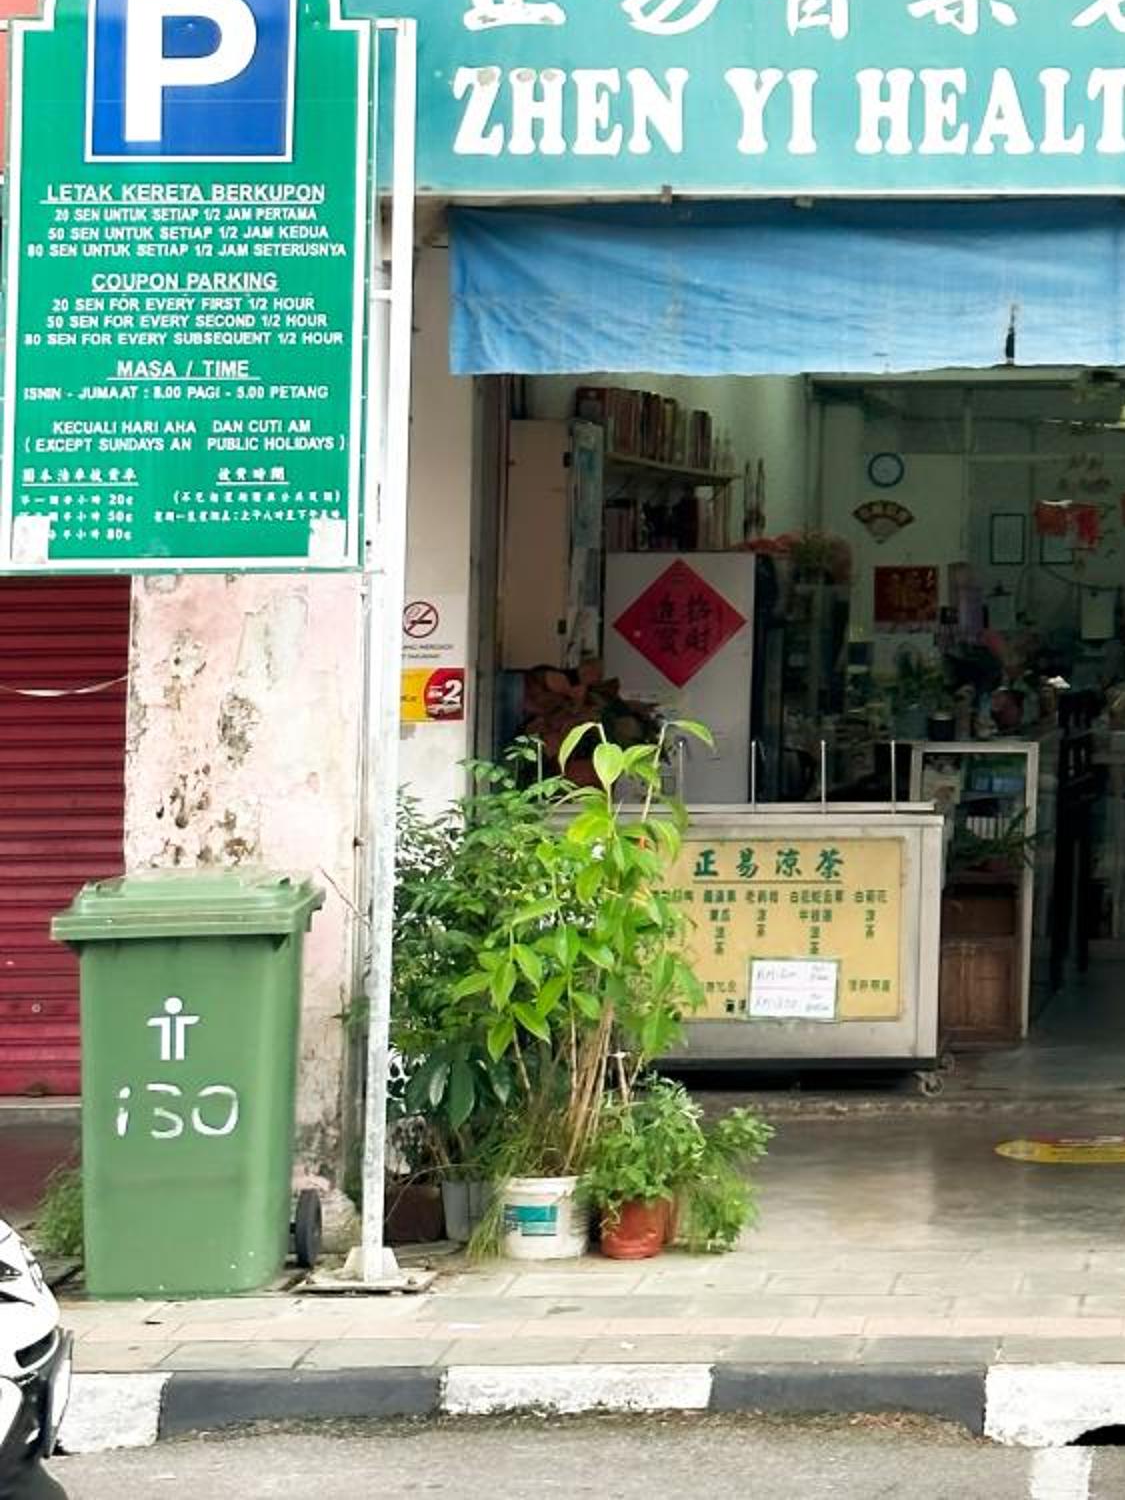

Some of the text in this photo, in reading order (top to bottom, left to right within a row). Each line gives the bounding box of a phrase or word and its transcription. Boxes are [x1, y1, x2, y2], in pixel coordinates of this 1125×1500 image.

[451, 65, 690, 157] ZHEN
[725, 67, 820, 155] YI
[47, 184, 325, 201] LETAK KERETA BERKUPON
[54, 208, 317, 221] 20 SEN UNTUK SETIAP 1/2 JAM PERTAMA
[48, 226, 329, 240] 50 SEN UNTUK SETIAP 1/2 JAM KEDUA
[50, 244, 77, 257] SEN
[83, 244, 130, 257] UNTUK
[137, 244, 188, 257] SETIAP
[195, 244, 213, 257] 1/2
[218, 244, 248, 256] JAM
[254, 244, 346, 256] SETERUSNYA
[91, 273, 277, 290] COUPON PARKING
[52, 298, 315, 311] 20 SEN FOR EVERY FIRST 1/2 HOUR
[47, 314, 327, 328] 50 SEN FOR EVERY SECOND 1/2 HOUR
[48, 334, 76, 345] SEN
[82, 334, 112, 345] FOR
[118, 334, 166, 345] EVERY
[174, 333, 272, 345] SUBSEQUENT
[278, 332, 296, 344] 1/2
[302, 332, 344, 344] HOUR
[117, 360, 176, 377] MASA
[203, 360, 249, 376] TIME
[24, 388, 61, 400] ISNIN
[78, 387, 137, 399] JUMAAT
[188, 386, 219, 398] PAGI
[237, 387, 265, 398] 5.00
[270, 386, 328, 398] PETANG
[53, 421, 116, 434] KECUALI
[122, 421, 158, 433] HARI
[213, 420, 242, 432] DAN
[249, 420, 282, 432] CUTI
[288, 420, 311, 432] AM
[36, 439, 93, 451] EXCEPT
[99, 438, 164, 451] SUNDAYS
[208, 438, 258, 450] PUBLIC
[265, 437, 334, 450] HOLIDAYS
